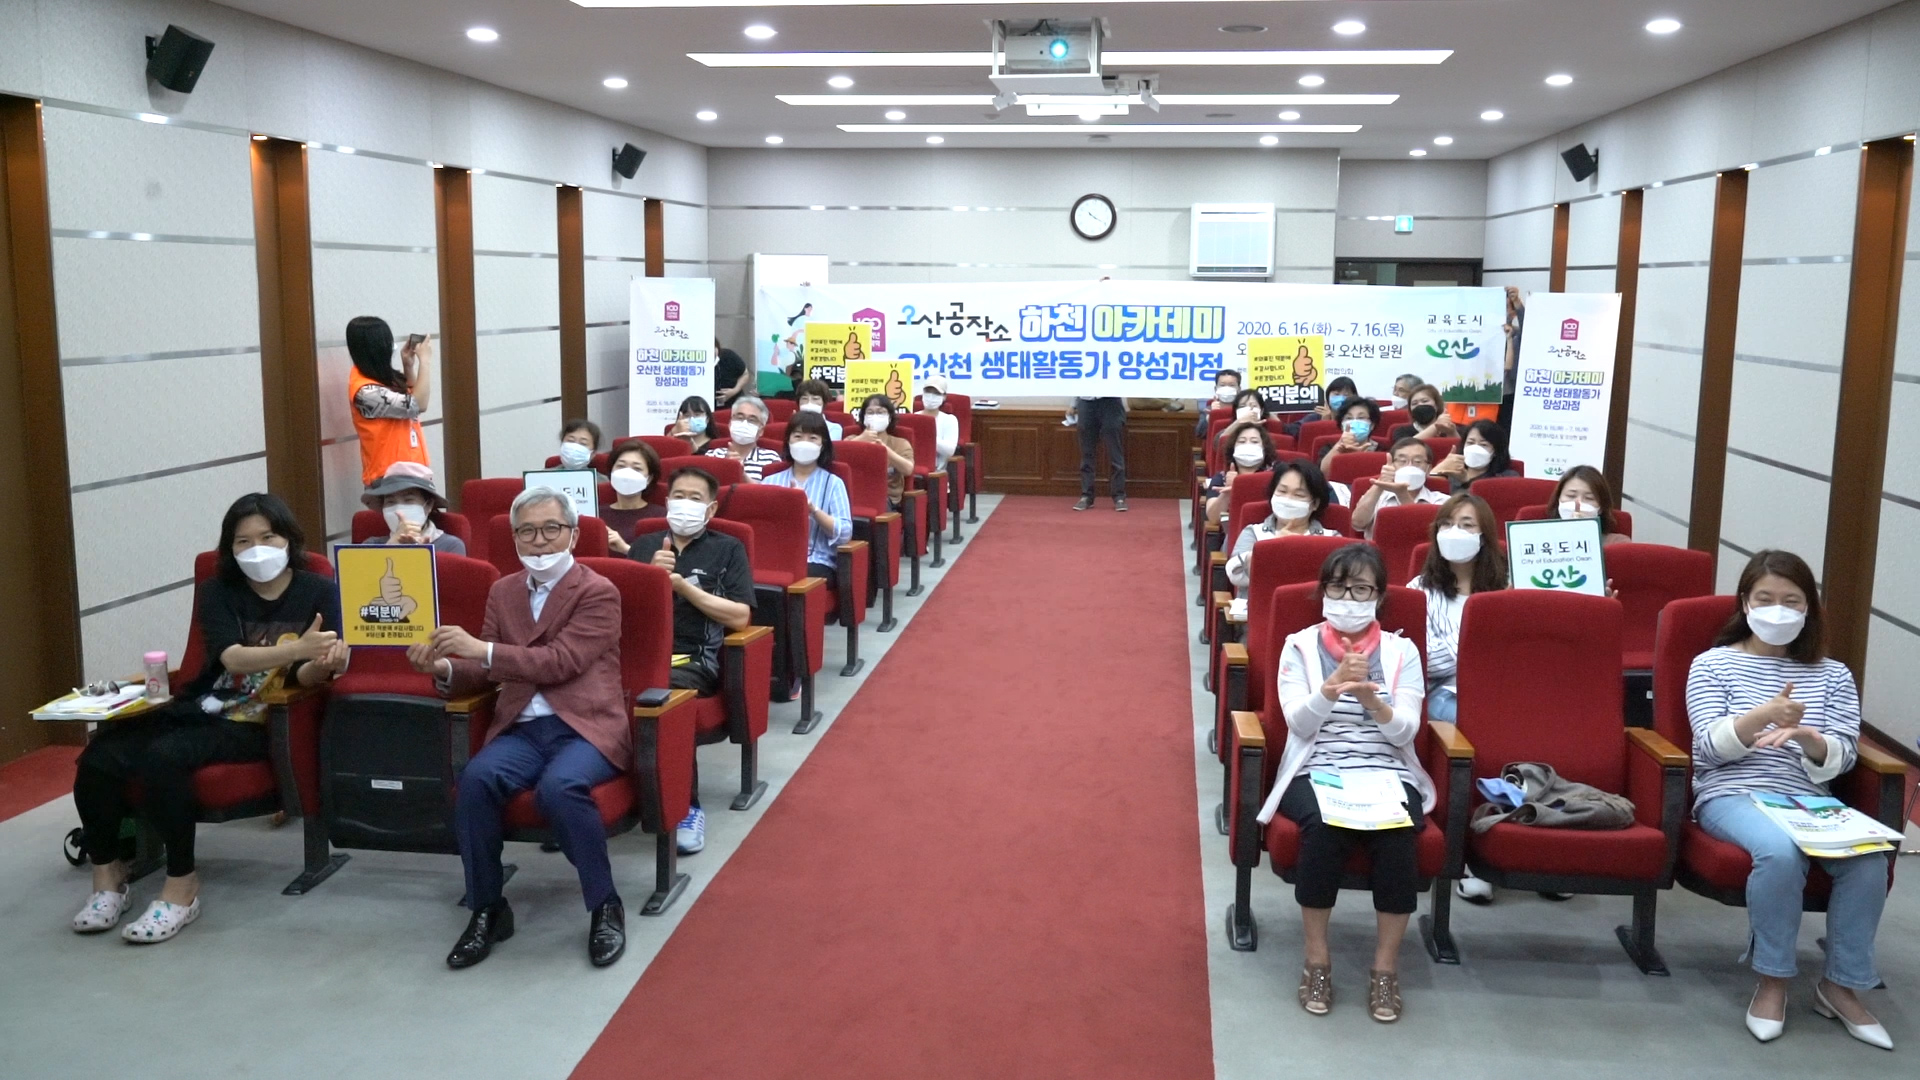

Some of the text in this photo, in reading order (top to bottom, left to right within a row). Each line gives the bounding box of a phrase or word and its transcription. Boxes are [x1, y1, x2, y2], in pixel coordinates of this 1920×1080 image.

[1019, 303, 1086, 342] 하천
[1092, 304, 1226, 344] 아카데미
[1427, 314, 1482, 326] 교육도시
[1236, 321, 1274, 336] 2020.
[1278, 321, 1290, 336] 6.
[1350, 322, 1361, 337] 7.
[636, 348, 707, 363] 하천 아카데미
[1324, 343, 1403, 359] 및 오산천 일원
[1426, 337, 1480, 360] 오산
[636, 365, 705, 376] 오산천 생태활동가
[980, 350, 1111, 380] 생태활동가
[1118, 351, 1223, 381] 양성과정
[655, 377, 688, 387] 양성과정
[810, 366, 846, 383] #덕분
[1525, 368, 1605, 386] 하천 아카데미
[1257, 384, 1319, 405] #덕분에
[1523, 385, 1601, 399] 오산천 생태활동가
[1543, 399, 1580, 411] 양성과정
[1523, 540, 1588, 555] 교육도시
[1543, 556, 1574, 564] Education
[1530, 565, 1587, 589] 오산
[360, 605, 401, 618] #덕분에
